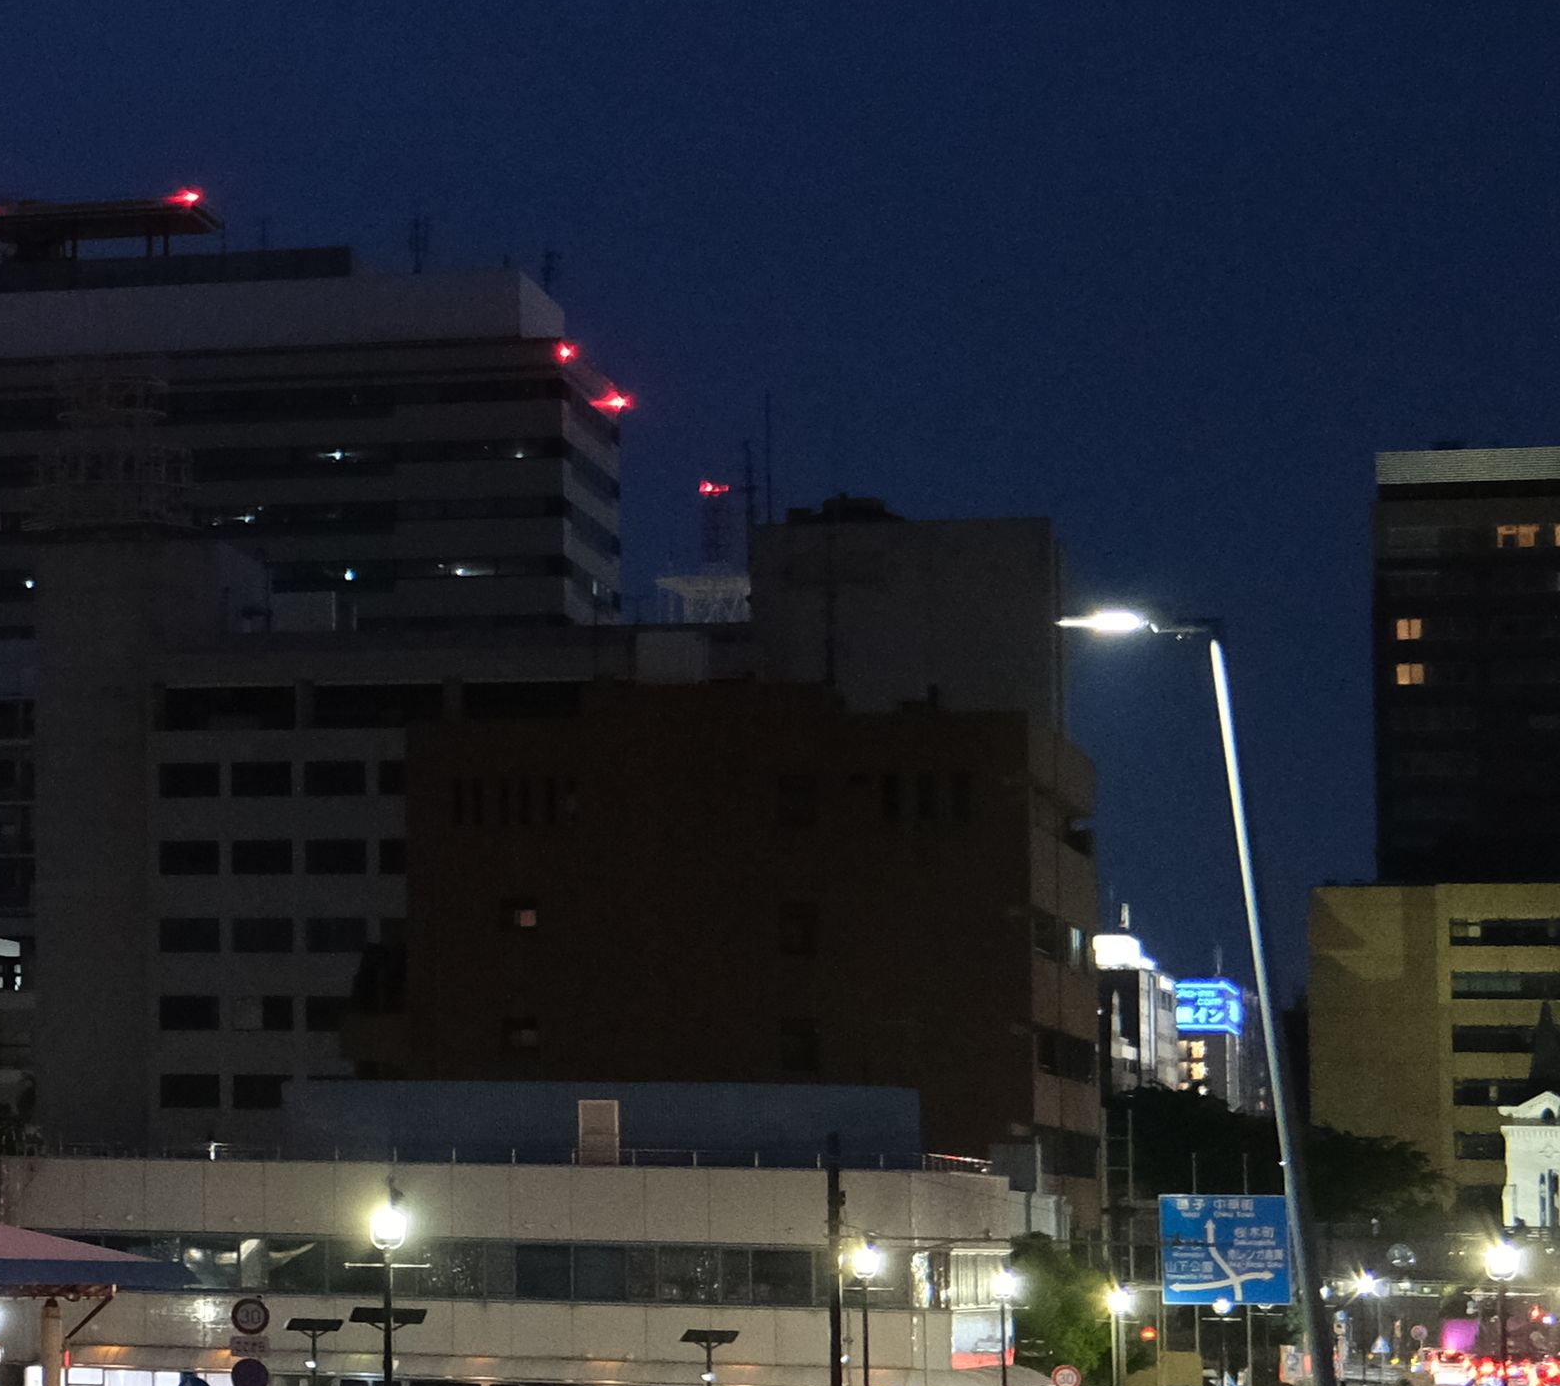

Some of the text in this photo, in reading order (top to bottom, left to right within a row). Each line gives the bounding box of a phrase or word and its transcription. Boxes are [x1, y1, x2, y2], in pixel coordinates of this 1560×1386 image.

[1213, 1199, 1254, 1211] 中華街
[1234, 1226, 1275, 1238] 桜木町
[1165, 1261, 1214, 1273] 山下公園
[239, 1309, 261, 1324] 30
[1058, 1373, 1074, 1384] 30
